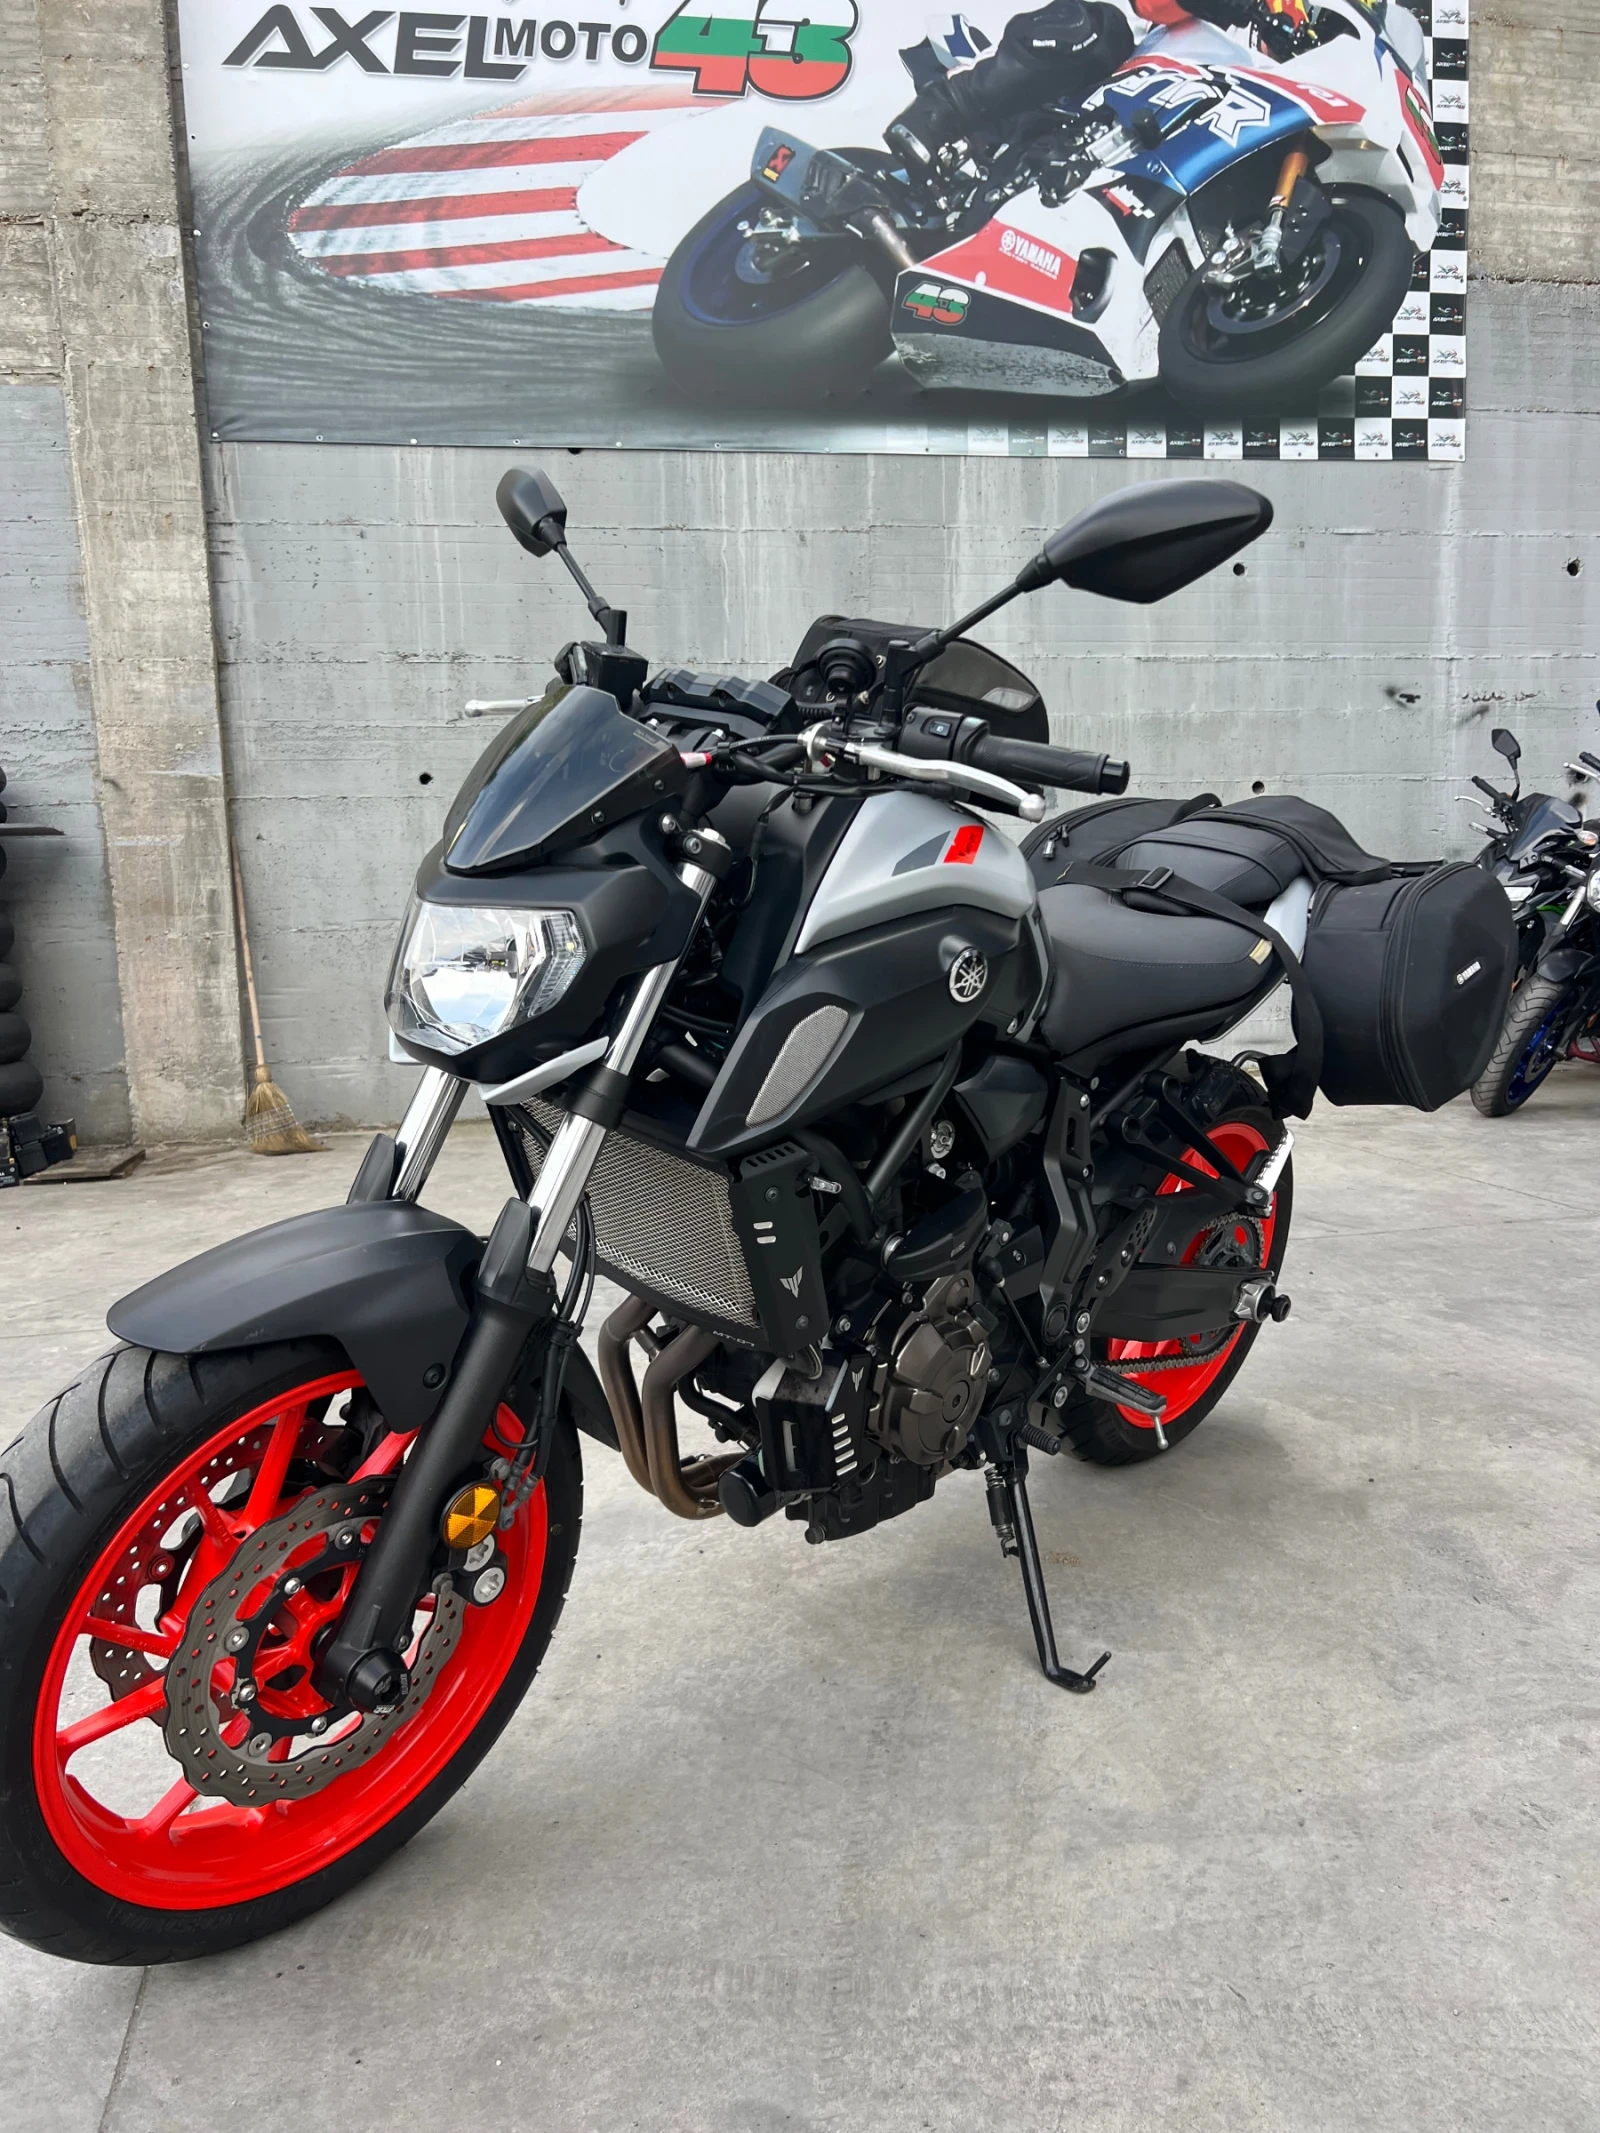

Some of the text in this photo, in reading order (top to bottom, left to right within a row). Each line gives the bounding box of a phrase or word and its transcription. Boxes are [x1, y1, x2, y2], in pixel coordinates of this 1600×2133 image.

[221, 0, 859, 101] AXEL MOTO 43
[1014, 234, 1062, 276] YAMAHA
[902, 281, 971, 325] 43
